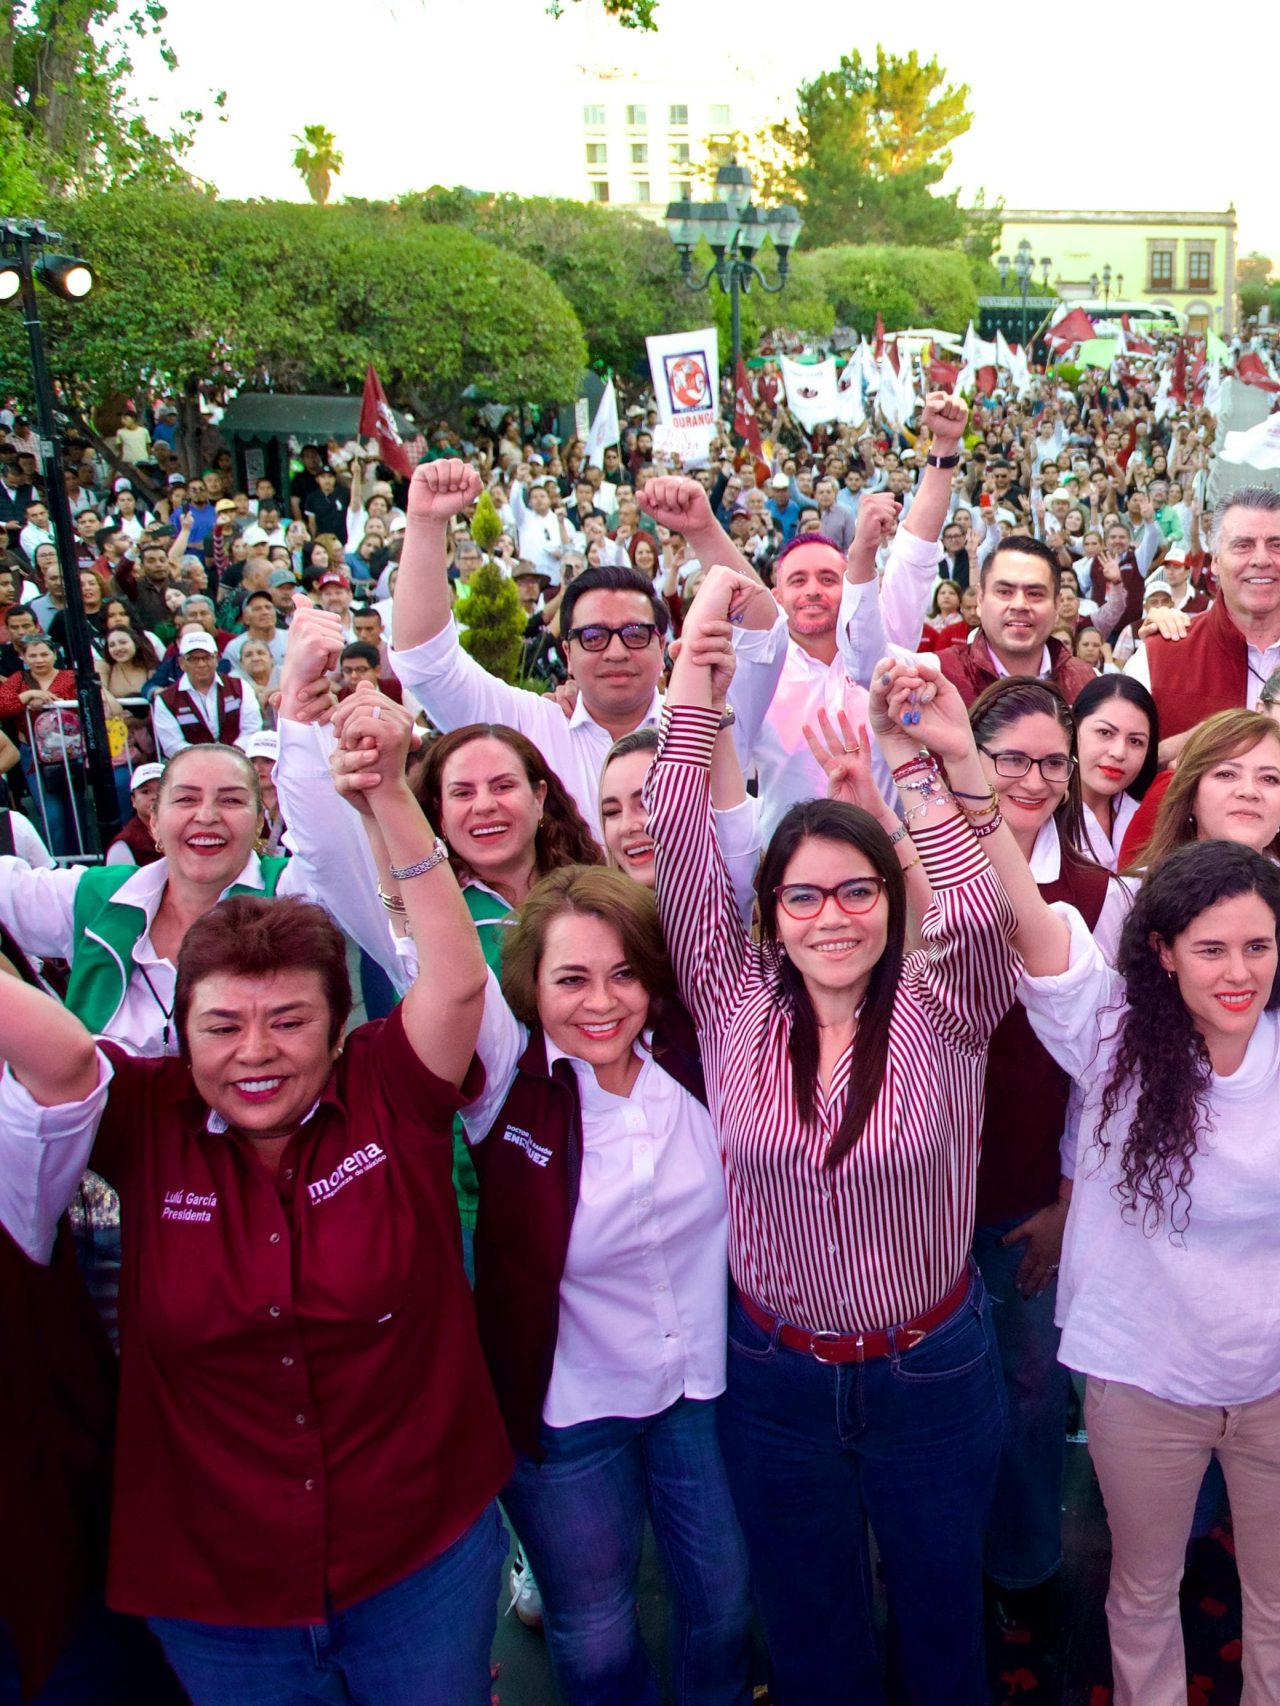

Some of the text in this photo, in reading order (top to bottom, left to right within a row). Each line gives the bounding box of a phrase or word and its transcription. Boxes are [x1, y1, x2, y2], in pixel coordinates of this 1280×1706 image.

[307, 1143, 384, 1199] morena
[164, 1189, 217, 1207] Lulú García
[161, 1207, 212, 1222] Presidenta
